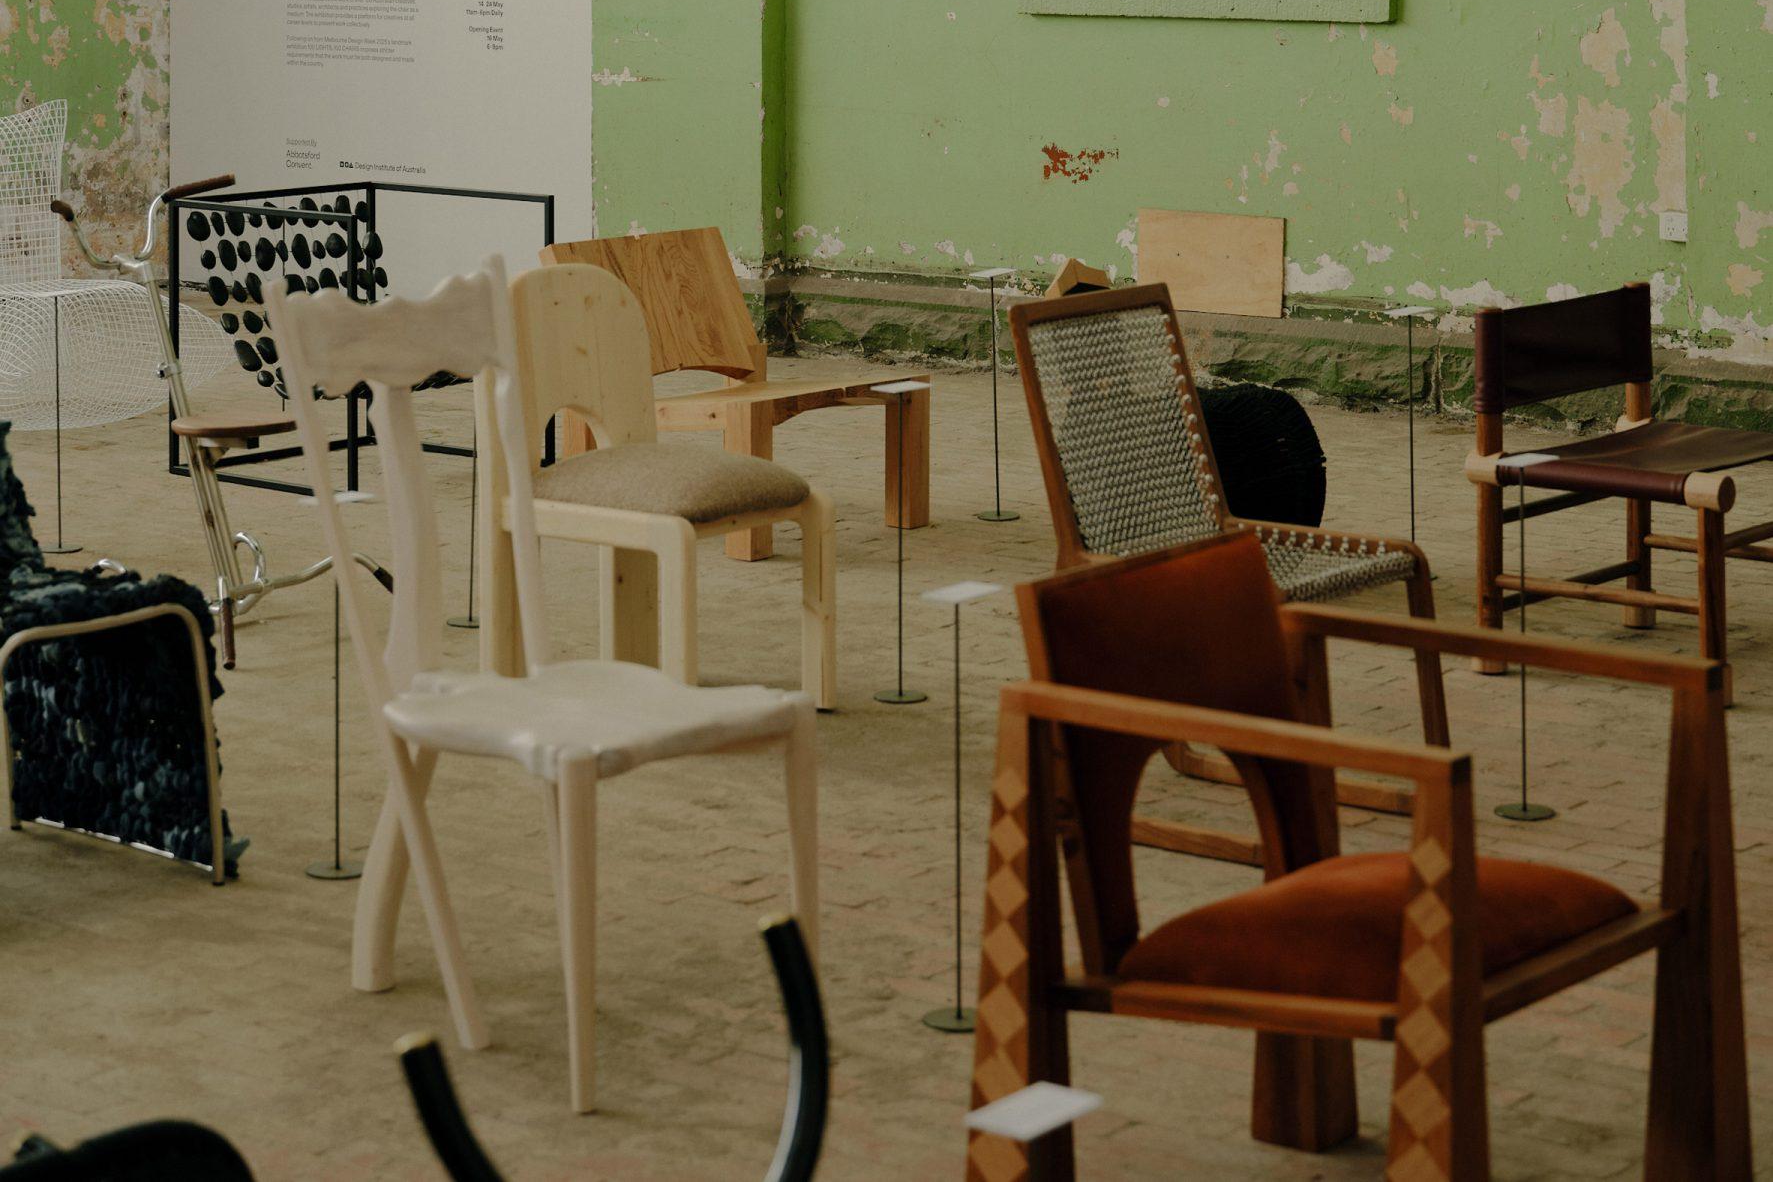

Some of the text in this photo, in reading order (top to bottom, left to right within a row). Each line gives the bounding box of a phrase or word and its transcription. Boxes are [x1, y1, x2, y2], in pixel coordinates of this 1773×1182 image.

[286, 150, 320, 159] Abbotsford
[286, 160, 312, 169] Convent
[355, 162, 373, 171] Design
[374, 164, 395, 172] Institute
[402, 165, 426, 174] Australia
